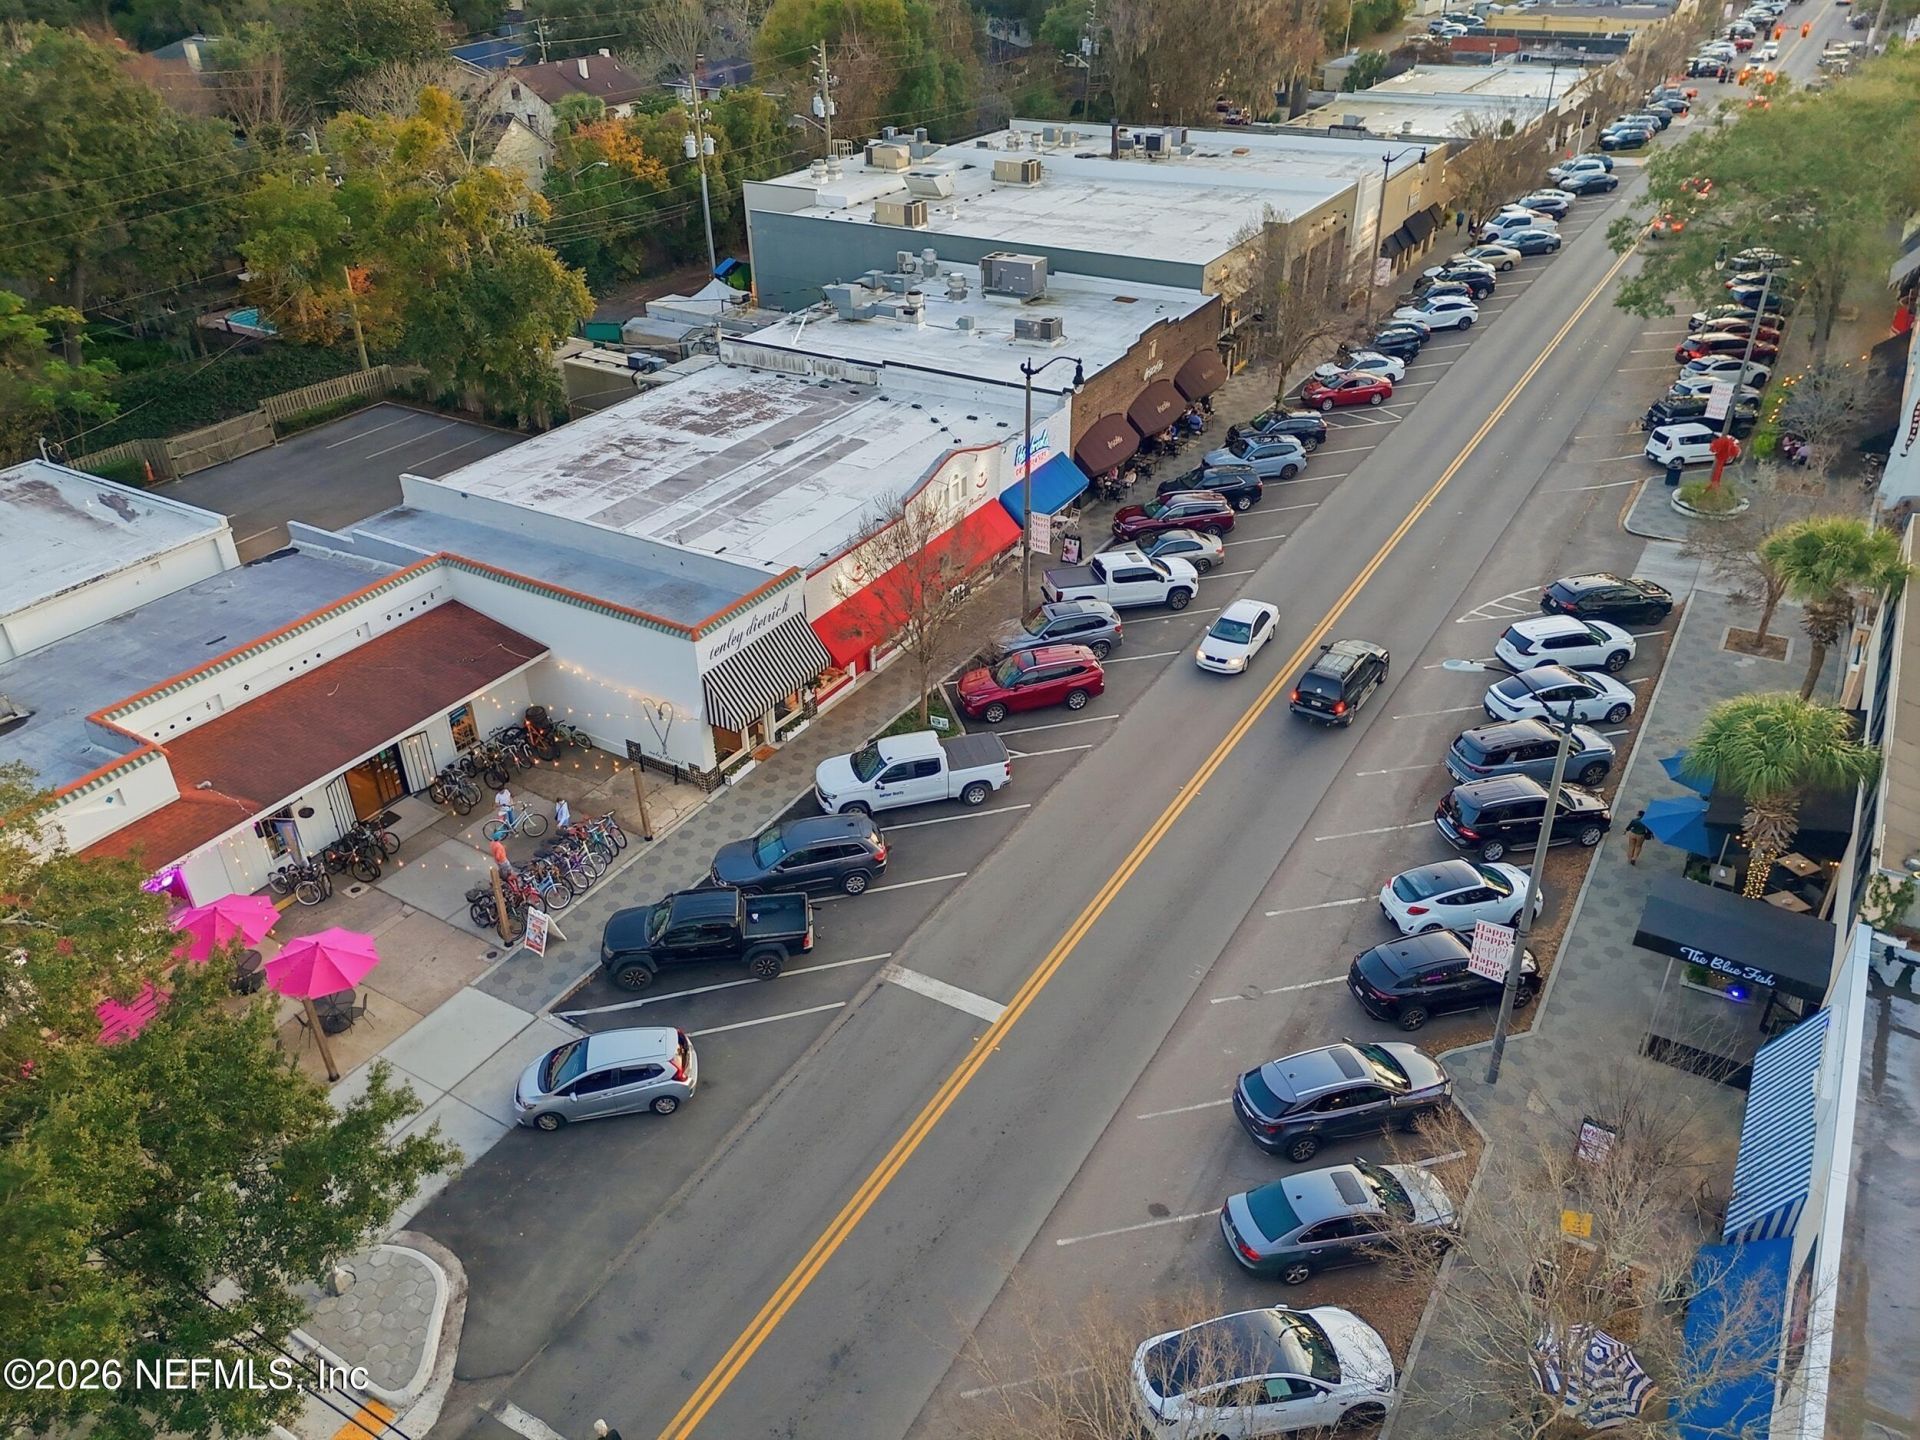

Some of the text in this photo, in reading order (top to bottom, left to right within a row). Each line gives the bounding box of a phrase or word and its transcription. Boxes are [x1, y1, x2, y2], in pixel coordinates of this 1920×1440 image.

[709, 593, 790, 660] tenley dietrich
[1475, 931, 1509, 948] Happy
[1477, 923, 1511, 940] Happy
[1470, 961, 1504, 980] Happy
[1471, 953, 1504, 970] Happy
[1680, 946, 1776, 986] The Blue Fish
